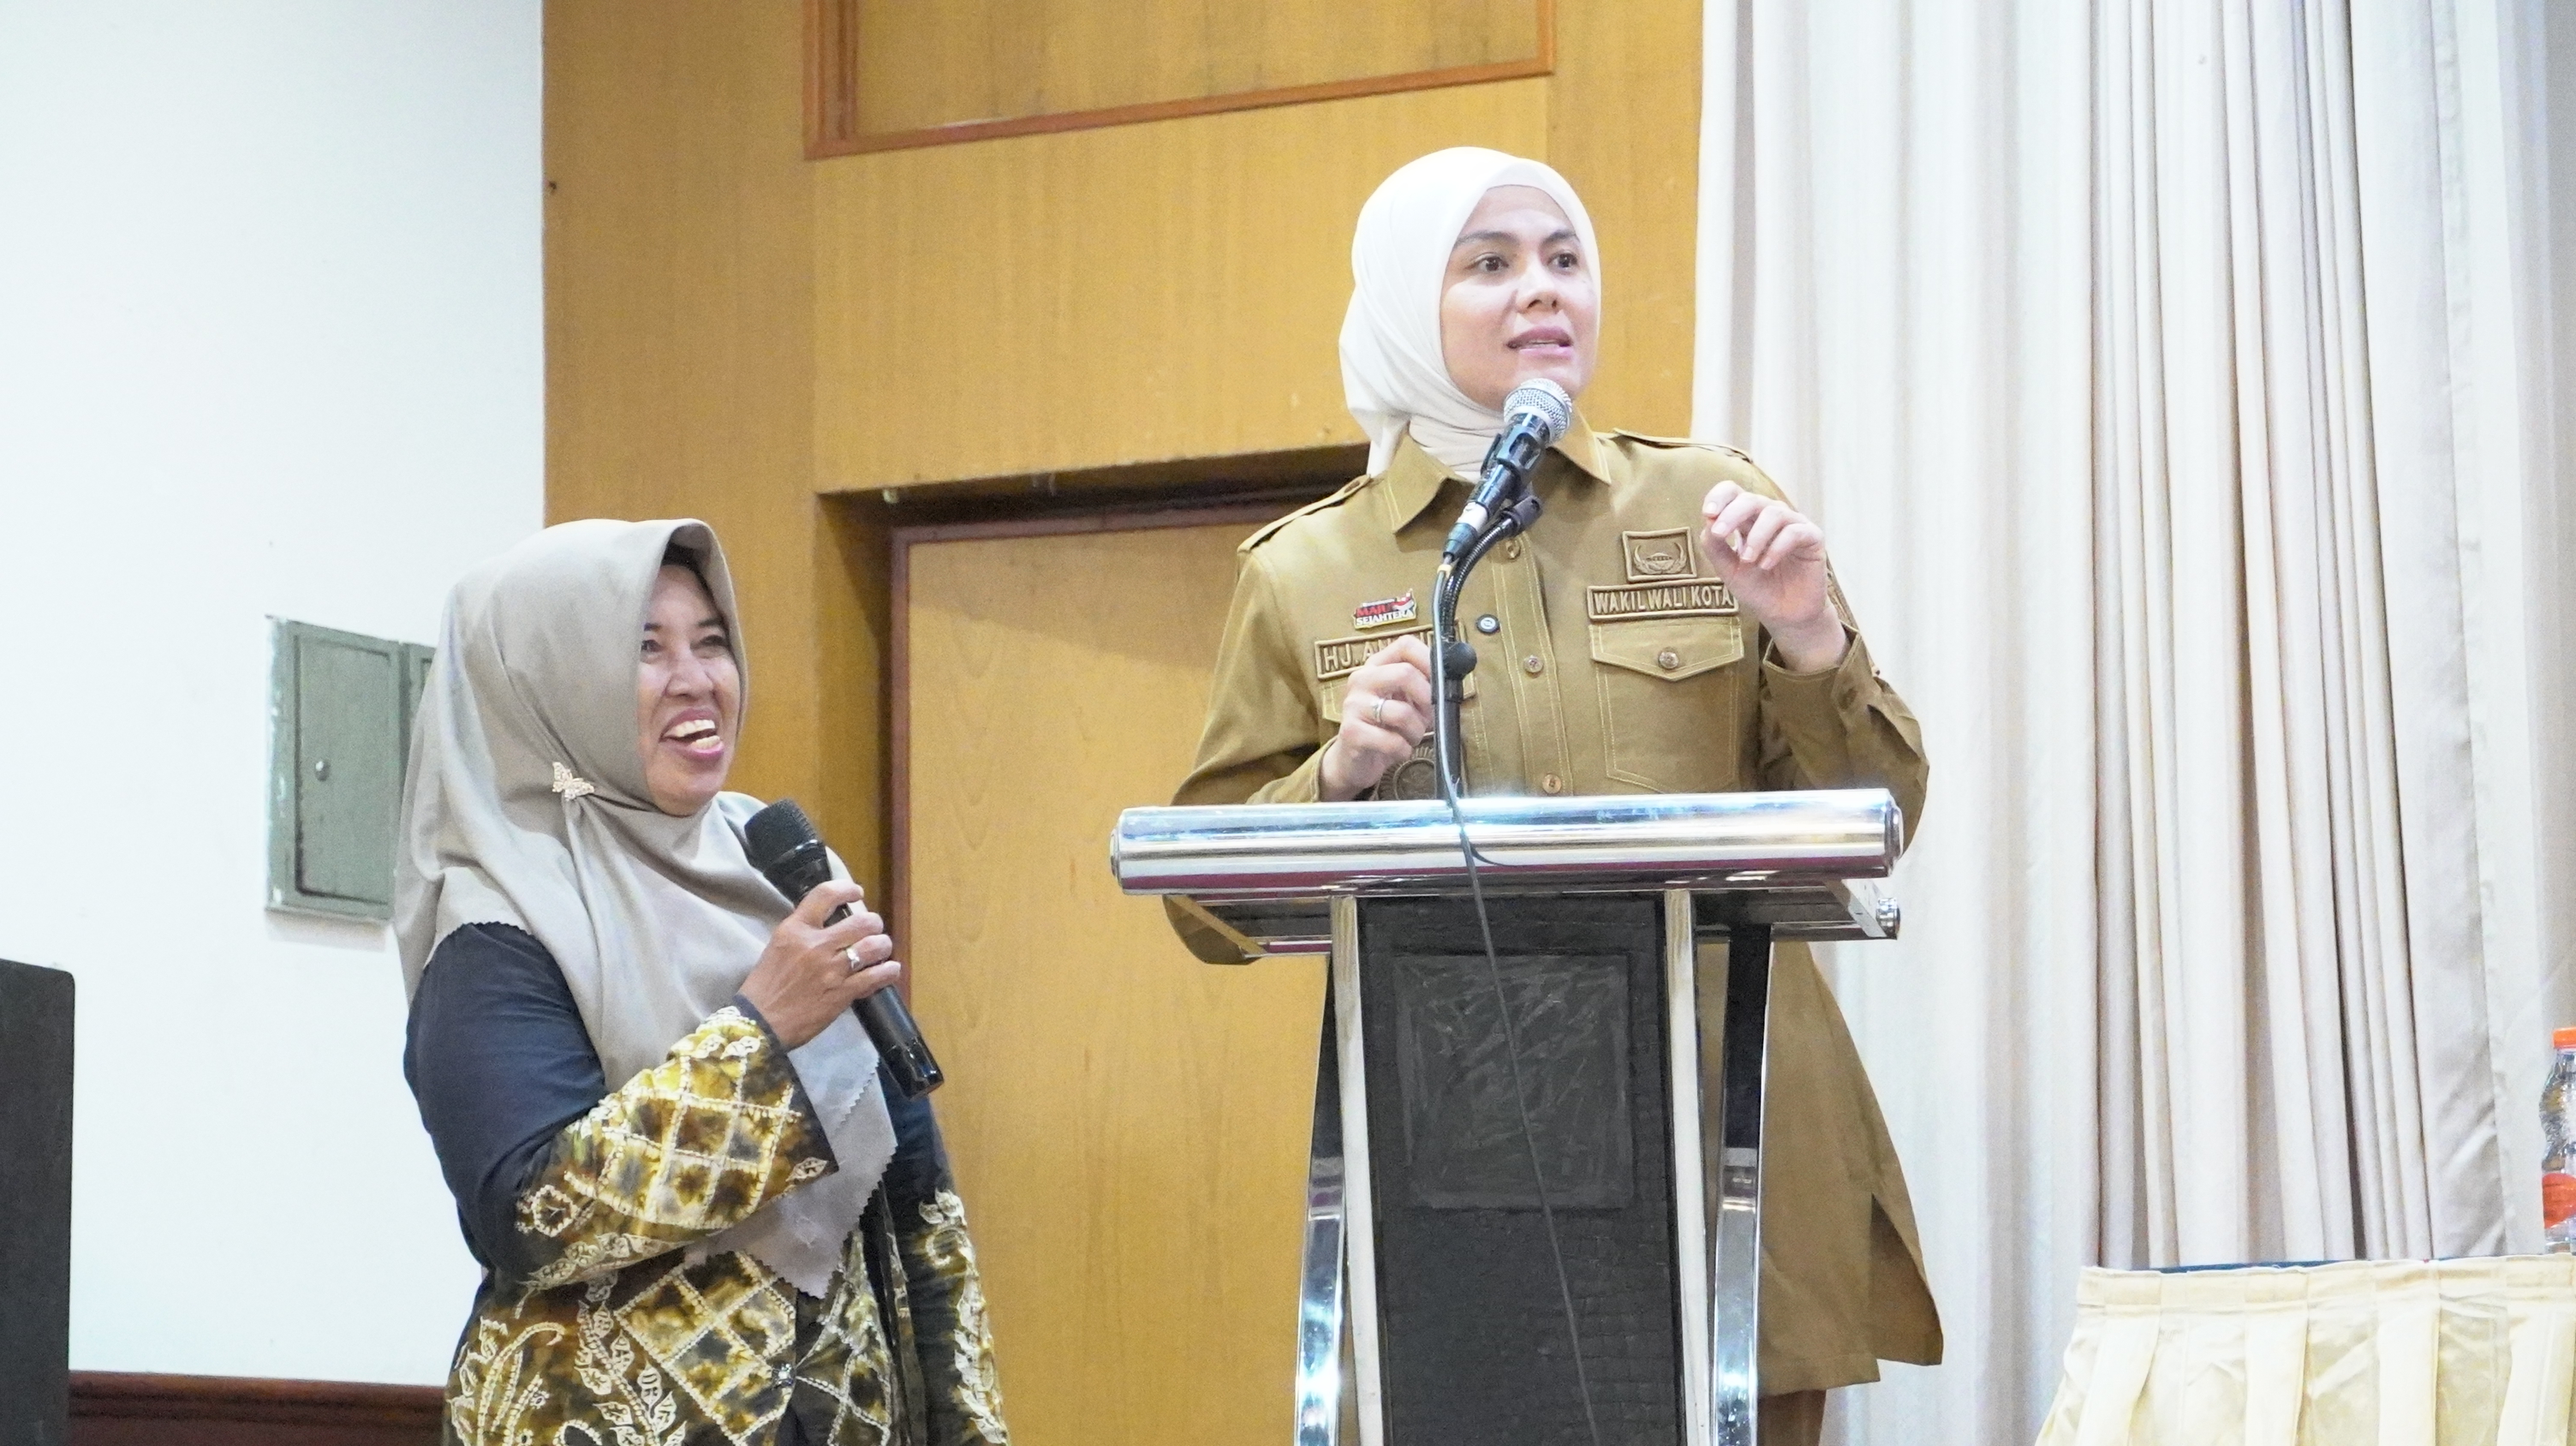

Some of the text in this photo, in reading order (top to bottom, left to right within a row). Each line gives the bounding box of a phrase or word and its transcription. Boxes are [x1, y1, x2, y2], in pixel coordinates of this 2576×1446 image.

[1594, 585, 1734, 614] WAKIL WALI KOTA
[1356, 609, 1415, 626] SEJAHTERA
